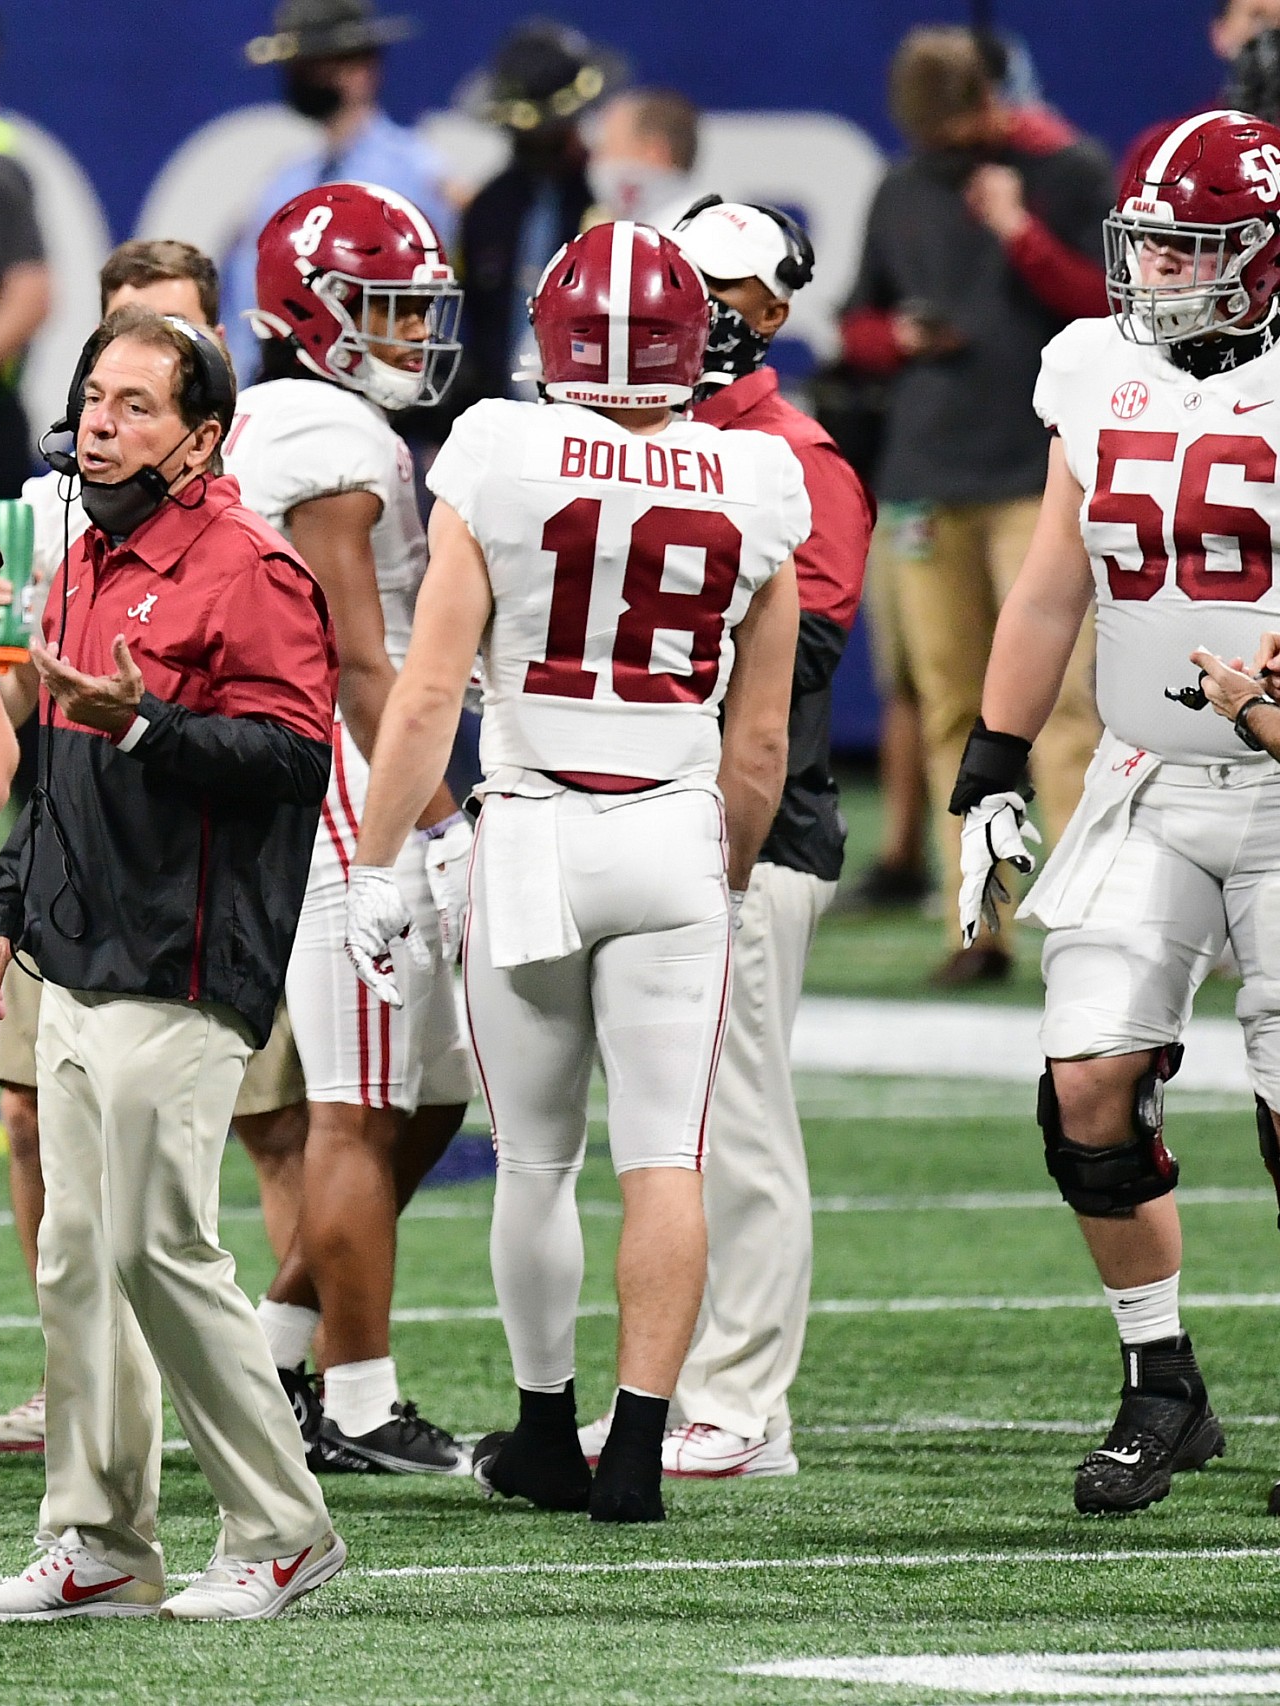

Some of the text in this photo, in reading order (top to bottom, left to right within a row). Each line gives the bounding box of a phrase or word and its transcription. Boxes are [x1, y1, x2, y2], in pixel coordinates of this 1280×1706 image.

[293, 205, 333, 257] 8
[566, 390, 668, 405] CRIMSON TIDE
[1111, 381, 1148, 420] SEC
[560, 436, 724, 495] BOLDEN
[1088, 429, 1277, 602] 56
[523, 497, 743, 705] 18
